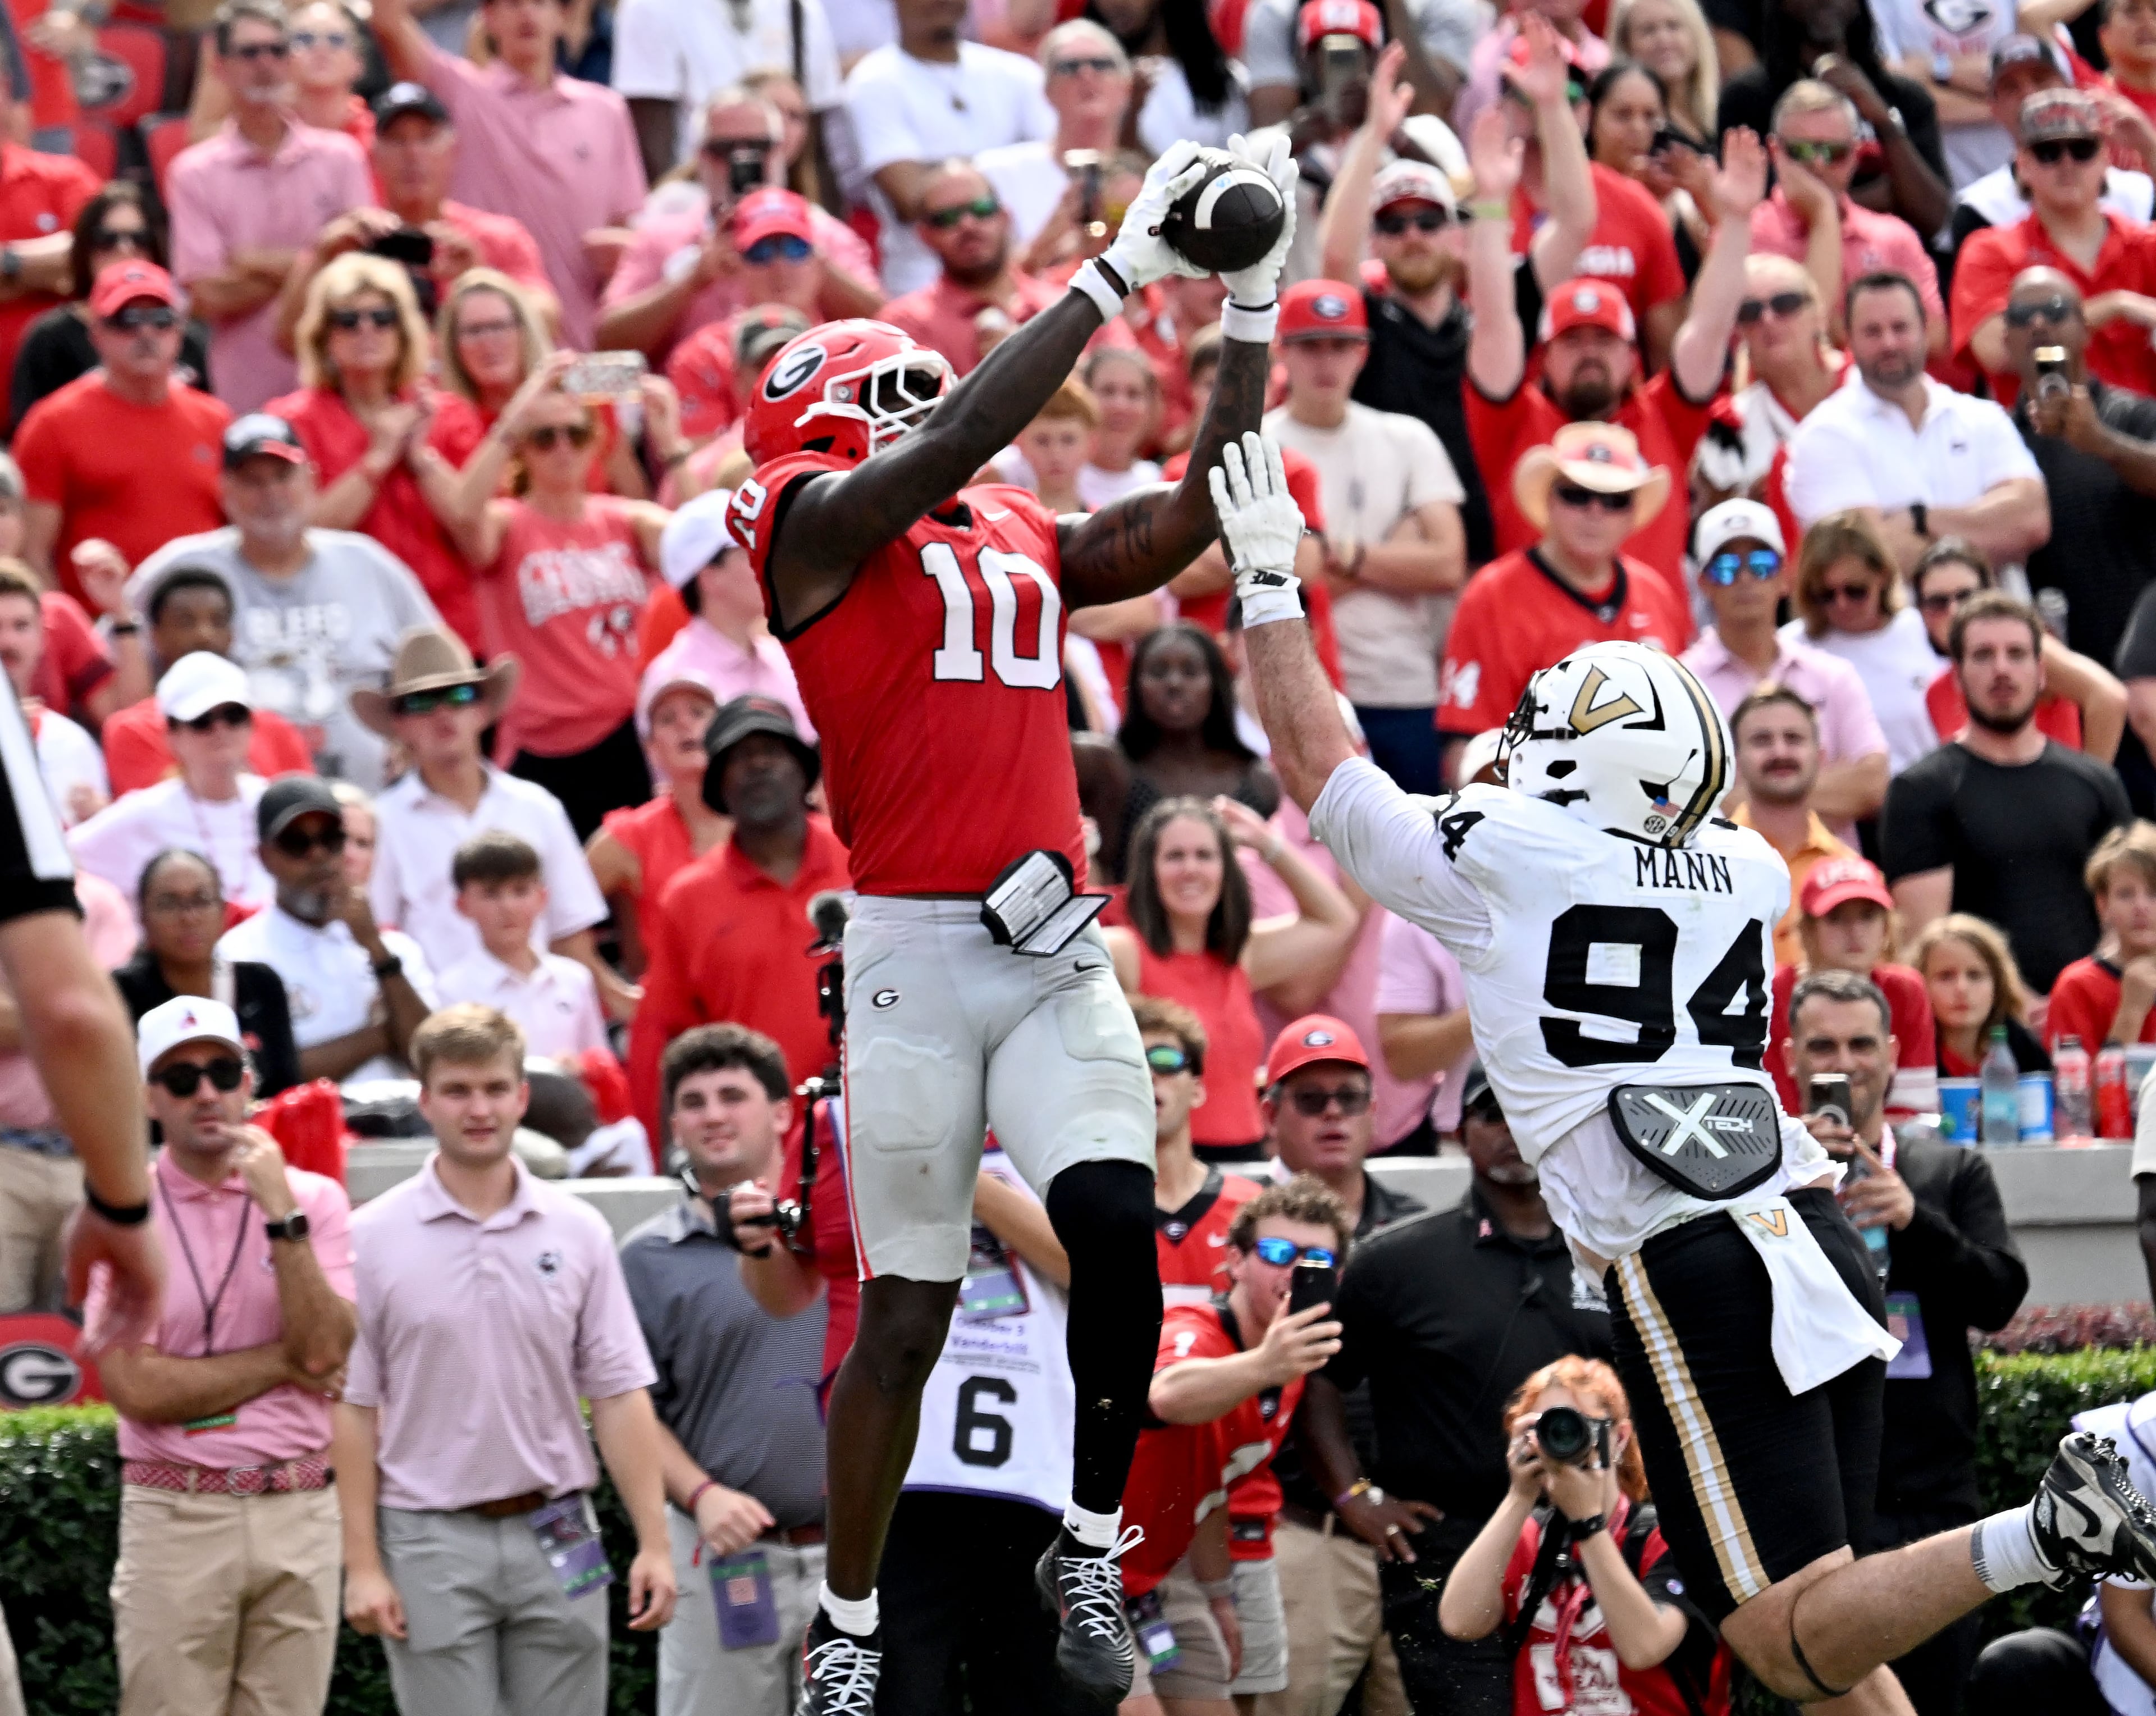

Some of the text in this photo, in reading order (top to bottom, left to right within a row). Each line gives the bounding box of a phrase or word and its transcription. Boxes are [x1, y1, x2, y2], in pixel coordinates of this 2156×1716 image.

[764, 344, 828, 401] G
[919, 541, 1062, 691] 10
[1633, 846, 1733, 894] MANN
[1540, 903, 1768, 1071] 94
[1746, 1208, 1788, 1237] V
[953, 1375, 1017, 1468] 6
